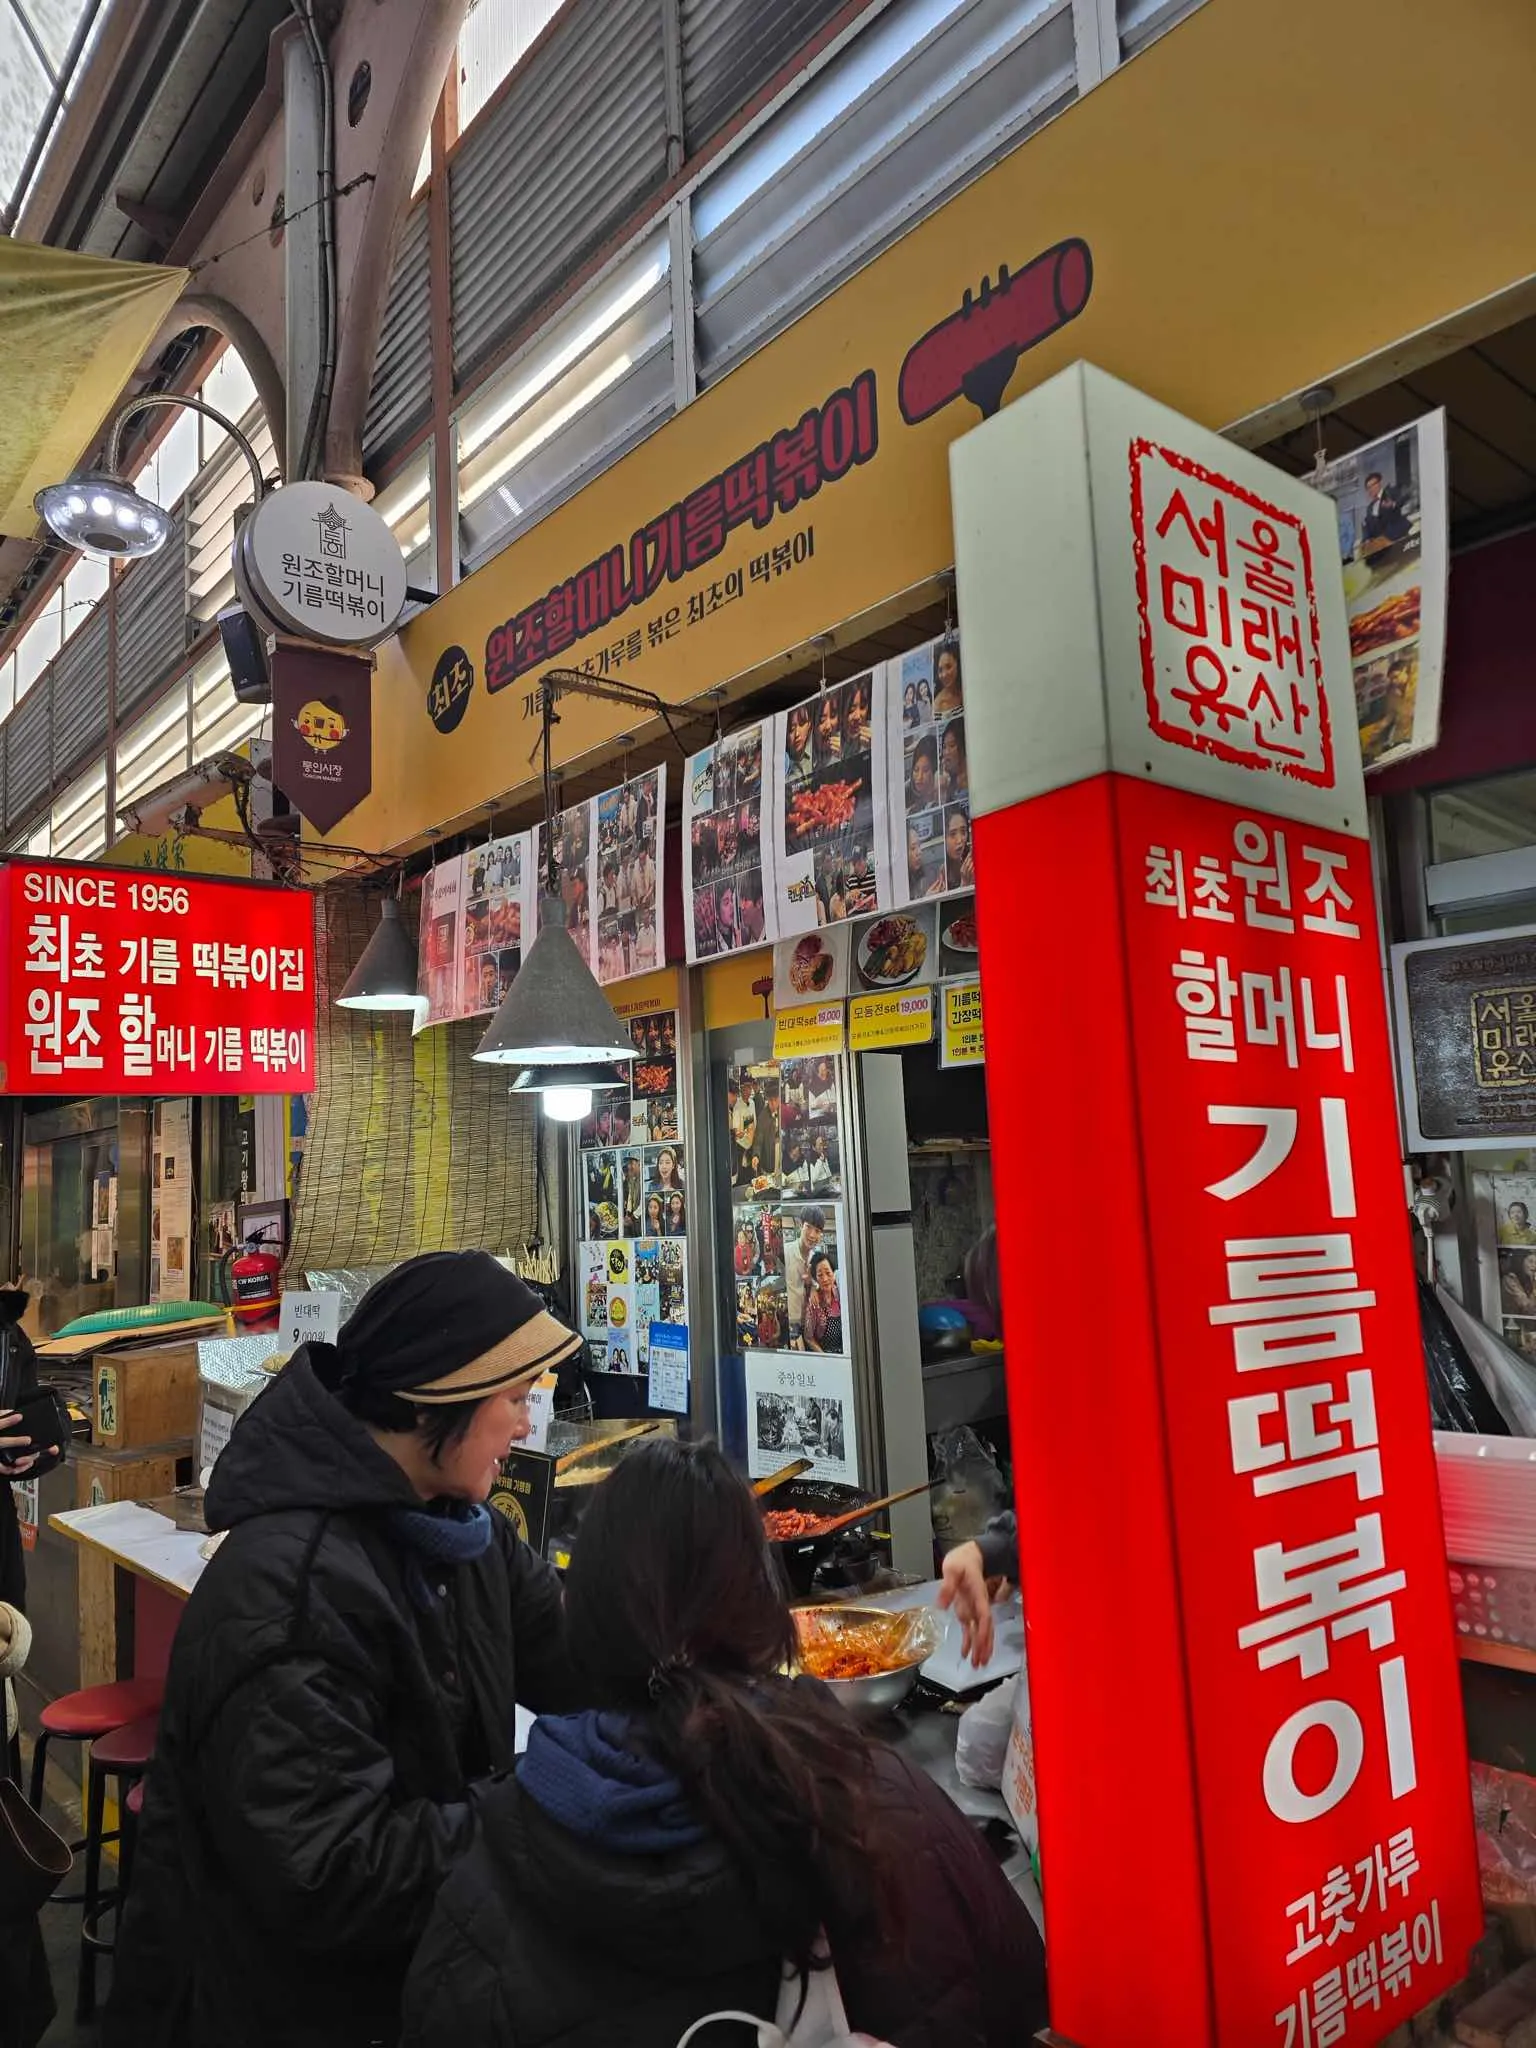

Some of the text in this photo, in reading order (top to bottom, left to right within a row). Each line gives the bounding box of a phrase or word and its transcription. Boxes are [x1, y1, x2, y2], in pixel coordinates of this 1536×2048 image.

[281, 553, 384, 598] 원조할머니
[1156, 487, 1297, 607] 서울
[283, 581, 385, 624] 기름떡볶이
[648, 607, 681, 648] 볶은
[687, 568, 743, 626] 최초의
[750, 526, 814, 584] 떡볶이
[1161, 564, 1306, 679] 미래
[432, 658, 468, 720] 최초
[1170, 646, 1311, 759] 유산
[303, 760, 343, 777] 통인시장
[24, 872, 189, 915] SINCE 1956
[25, 914, 304, 992] 최초 기름 떡볶이집
[24, 988, 306, 1076] 원조 할머니 기름 떡볶이
[900, 998, 928, 1014] 19,000
[1172, 949, 1354, 1073] 할머니
[1480, 993, 1536, 1024] 서울
[778, 1371, 817, 1387] 중앙일보
[1286, 1826, 1419, 1967] 고춧가루
[1275, 1898, 1443, 2048] 기름떡볶이
